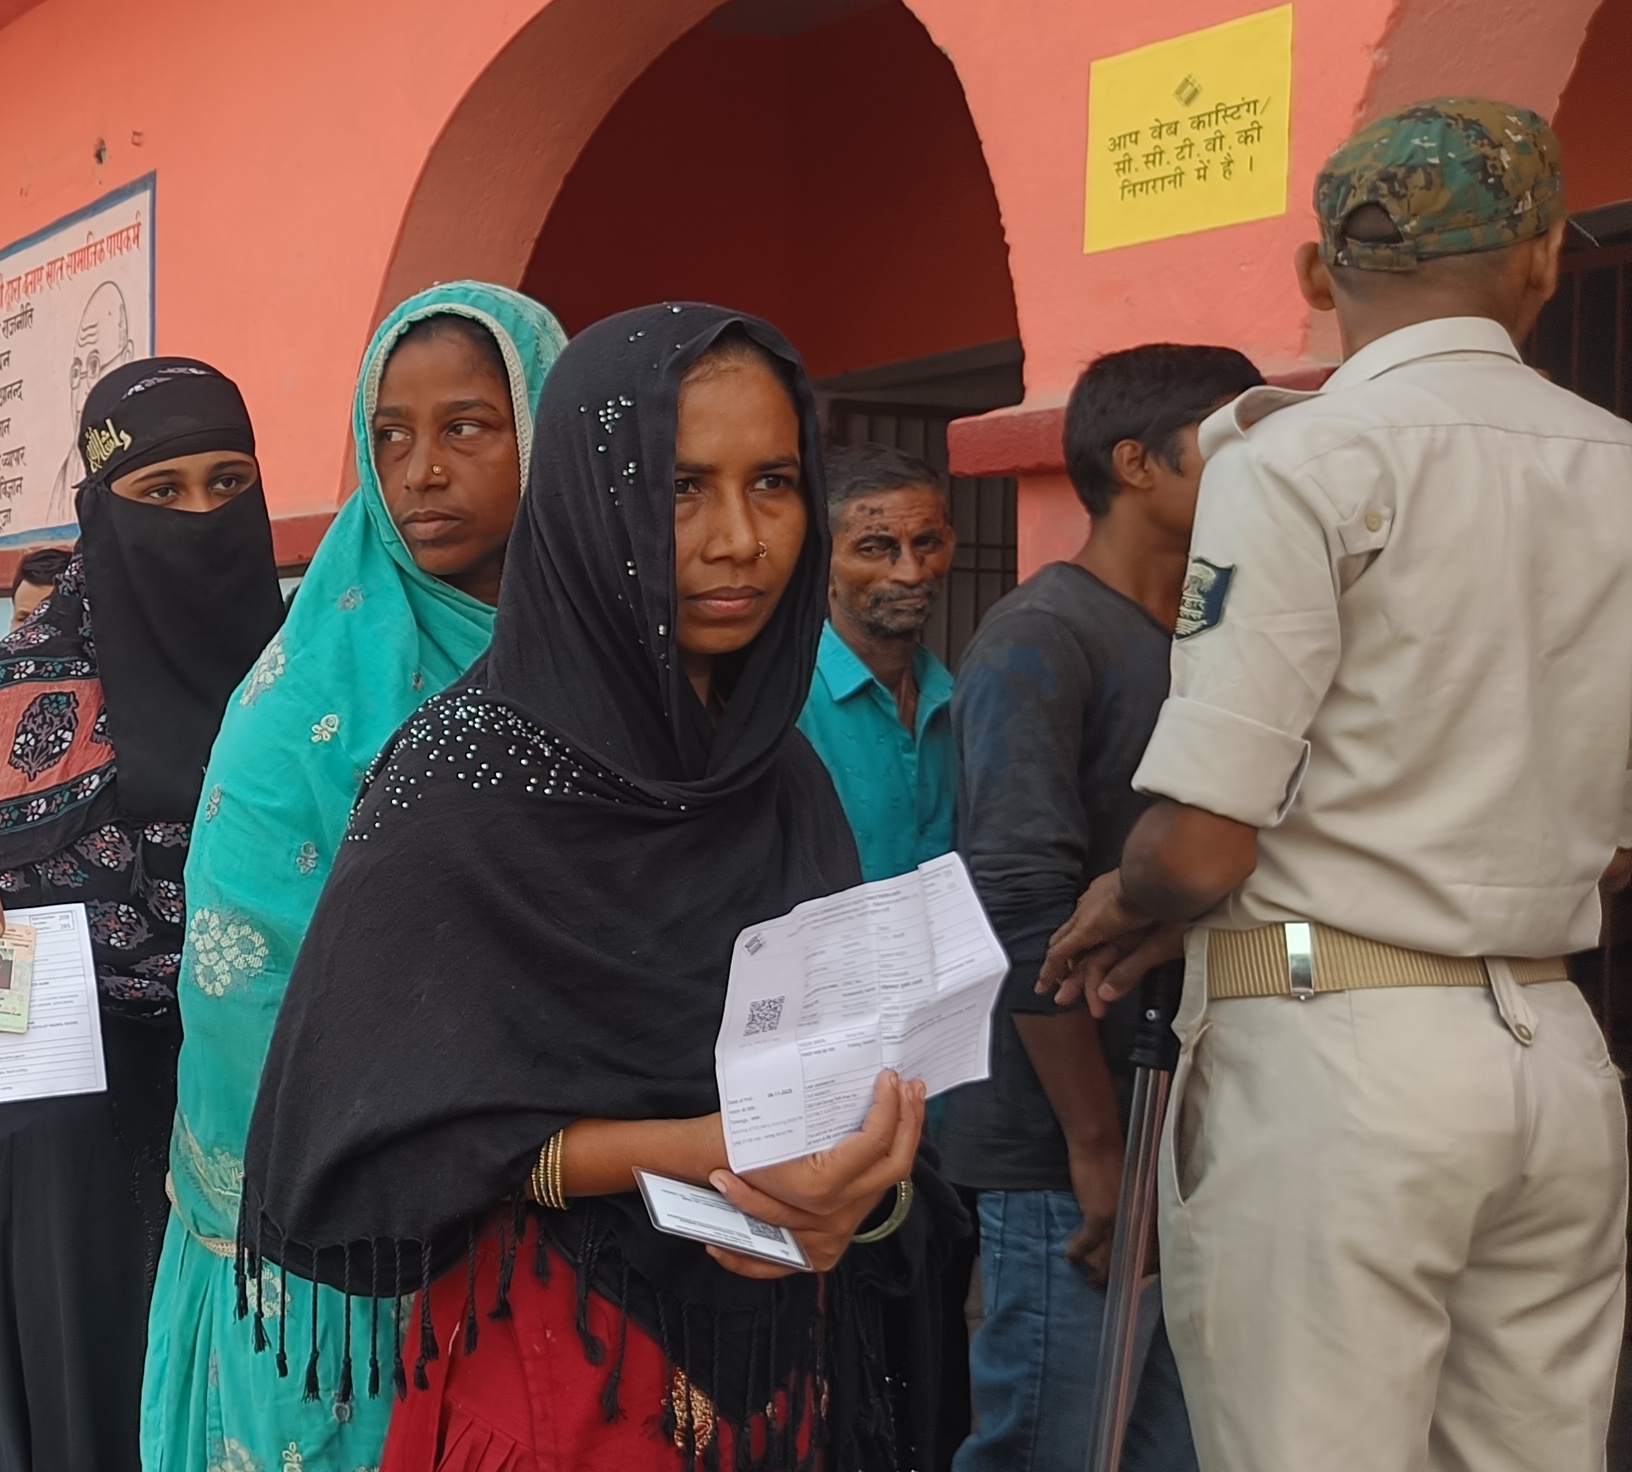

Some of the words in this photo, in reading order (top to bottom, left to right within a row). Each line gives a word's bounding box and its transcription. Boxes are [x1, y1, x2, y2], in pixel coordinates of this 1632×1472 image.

[1107, 130, 1140, 152] आप
[1150, 118, 1180, 140] वेब
[1236, 120, 1263, 145] की
[1120, 166, 1186, 201] निगरानी
[1195, 159, 1211, 182] में
[1220, 151, 1235, 181] है
[22, 266, 44, 300] बताए
[46, 257, 65, 290] सात
[66, 231, 106, 281] सामाजिक
[2, 302, 35, 340] राजनीति
[2, 445, 27, 467] व्यापार
[0, 475, 24, 502] विज्ञान
